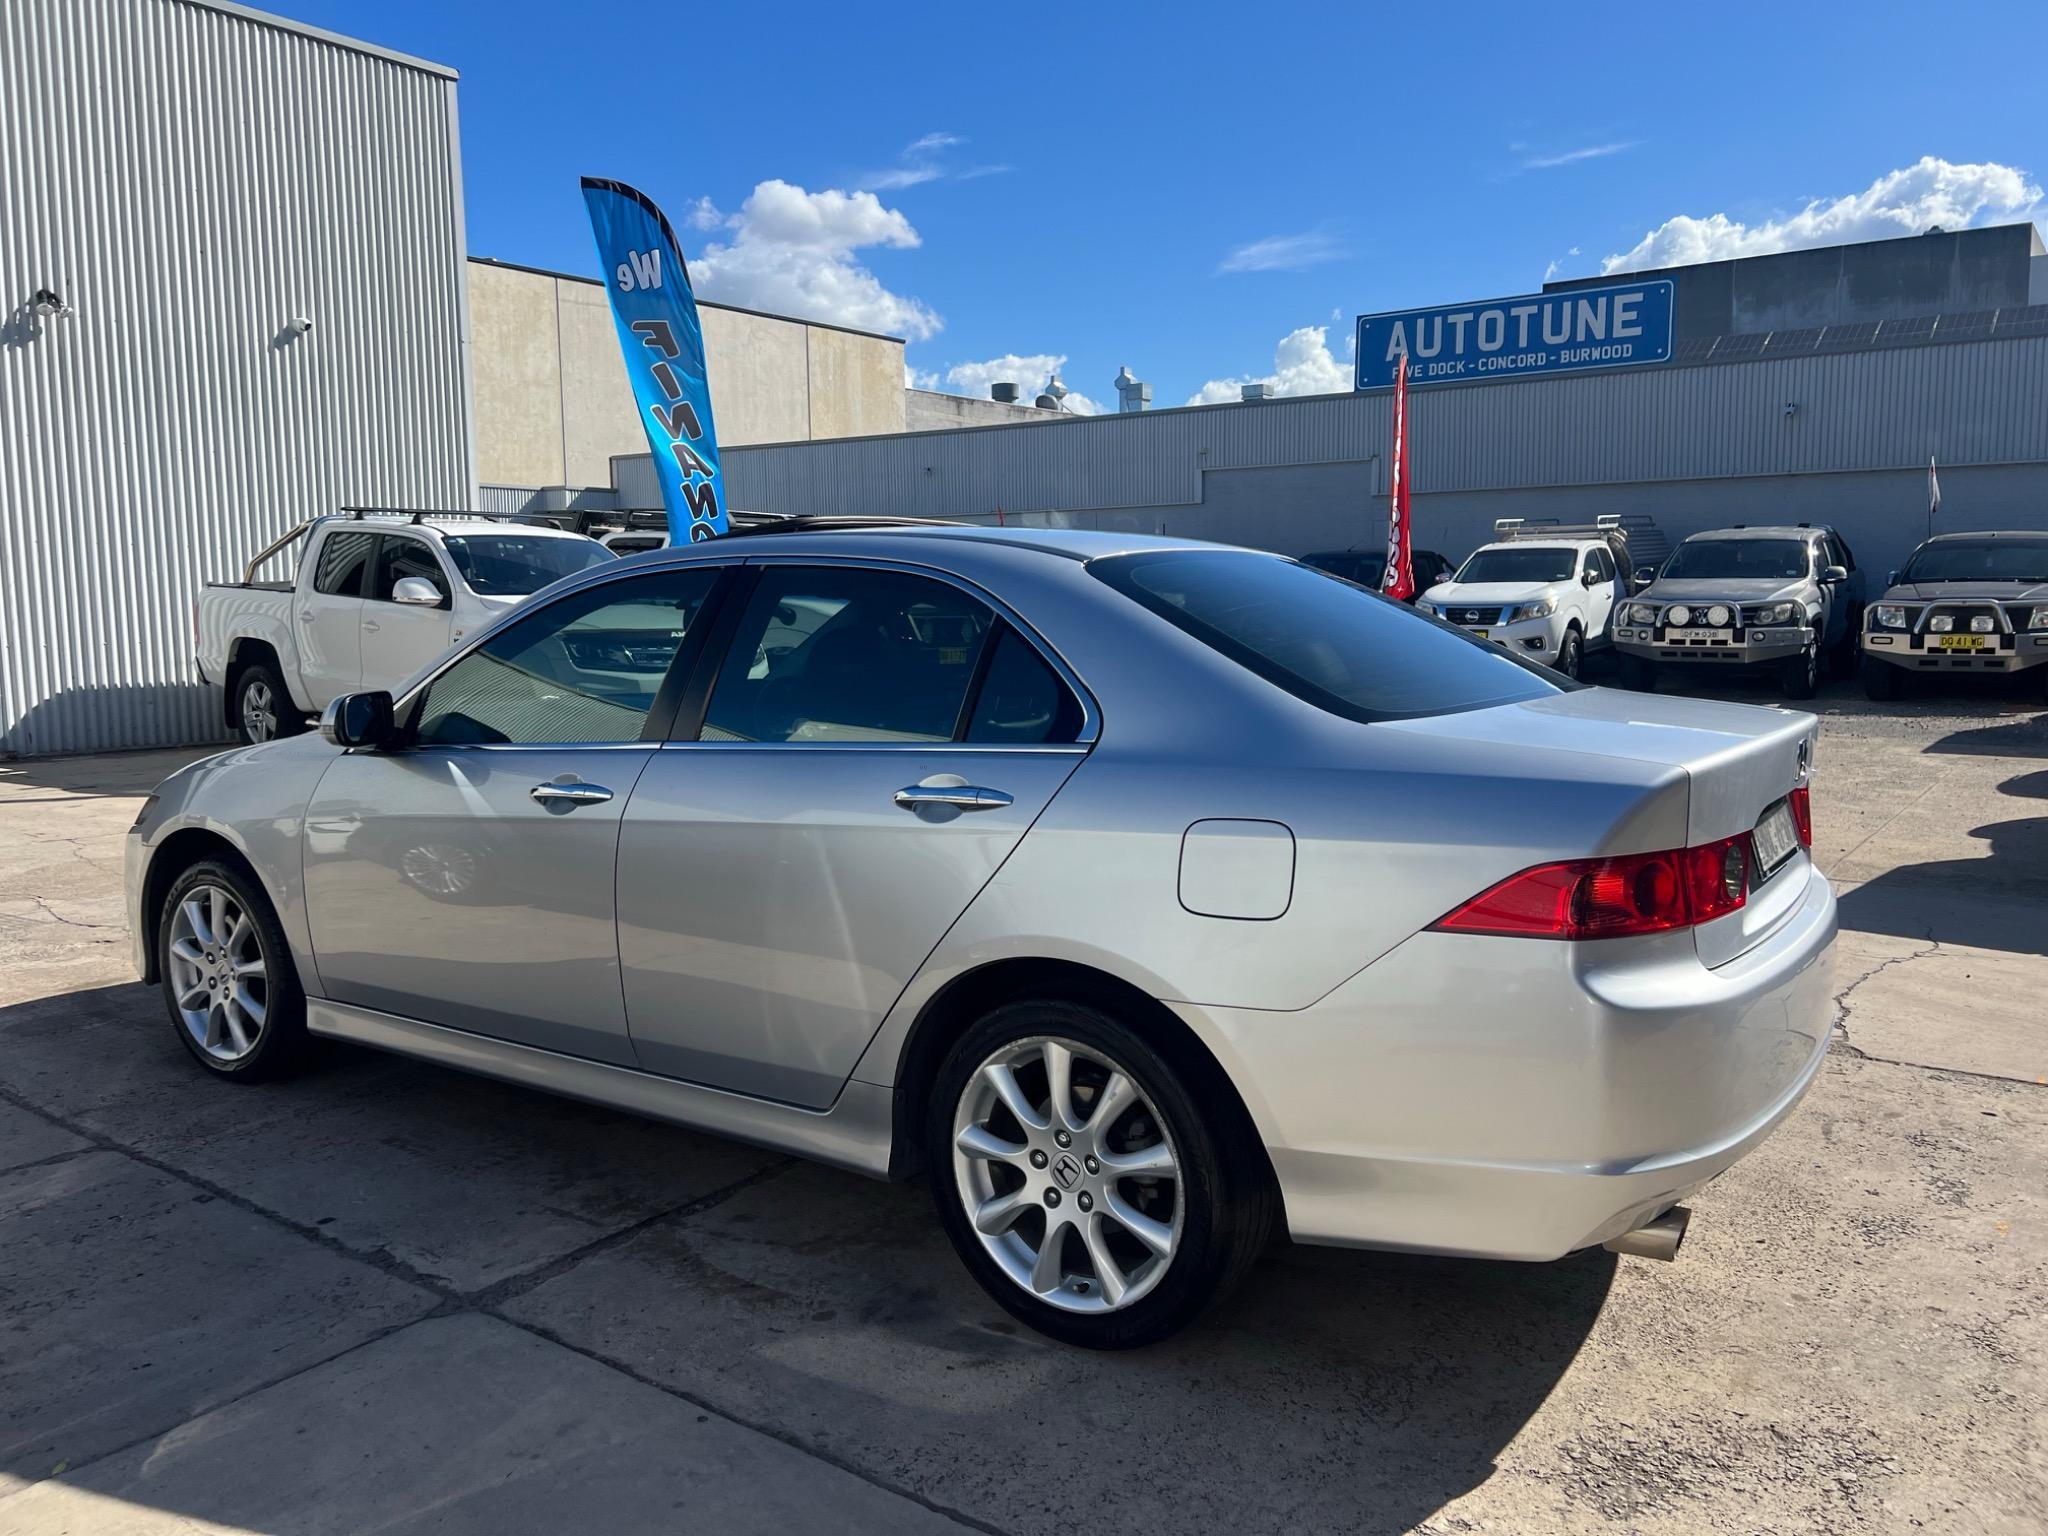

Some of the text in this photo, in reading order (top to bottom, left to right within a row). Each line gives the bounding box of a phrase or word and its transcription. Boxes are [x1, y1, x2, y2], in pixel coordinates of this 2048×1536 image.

[1386, 293, 1643, 361] AUTOTUNE
[1392, 364, 1423, 379] FVE
[1428, 361, 1465, 378] DOCK
[1478, 352, 1547, 372] CONCORD
[1560, 344, 1633, 364] BURWOOD
